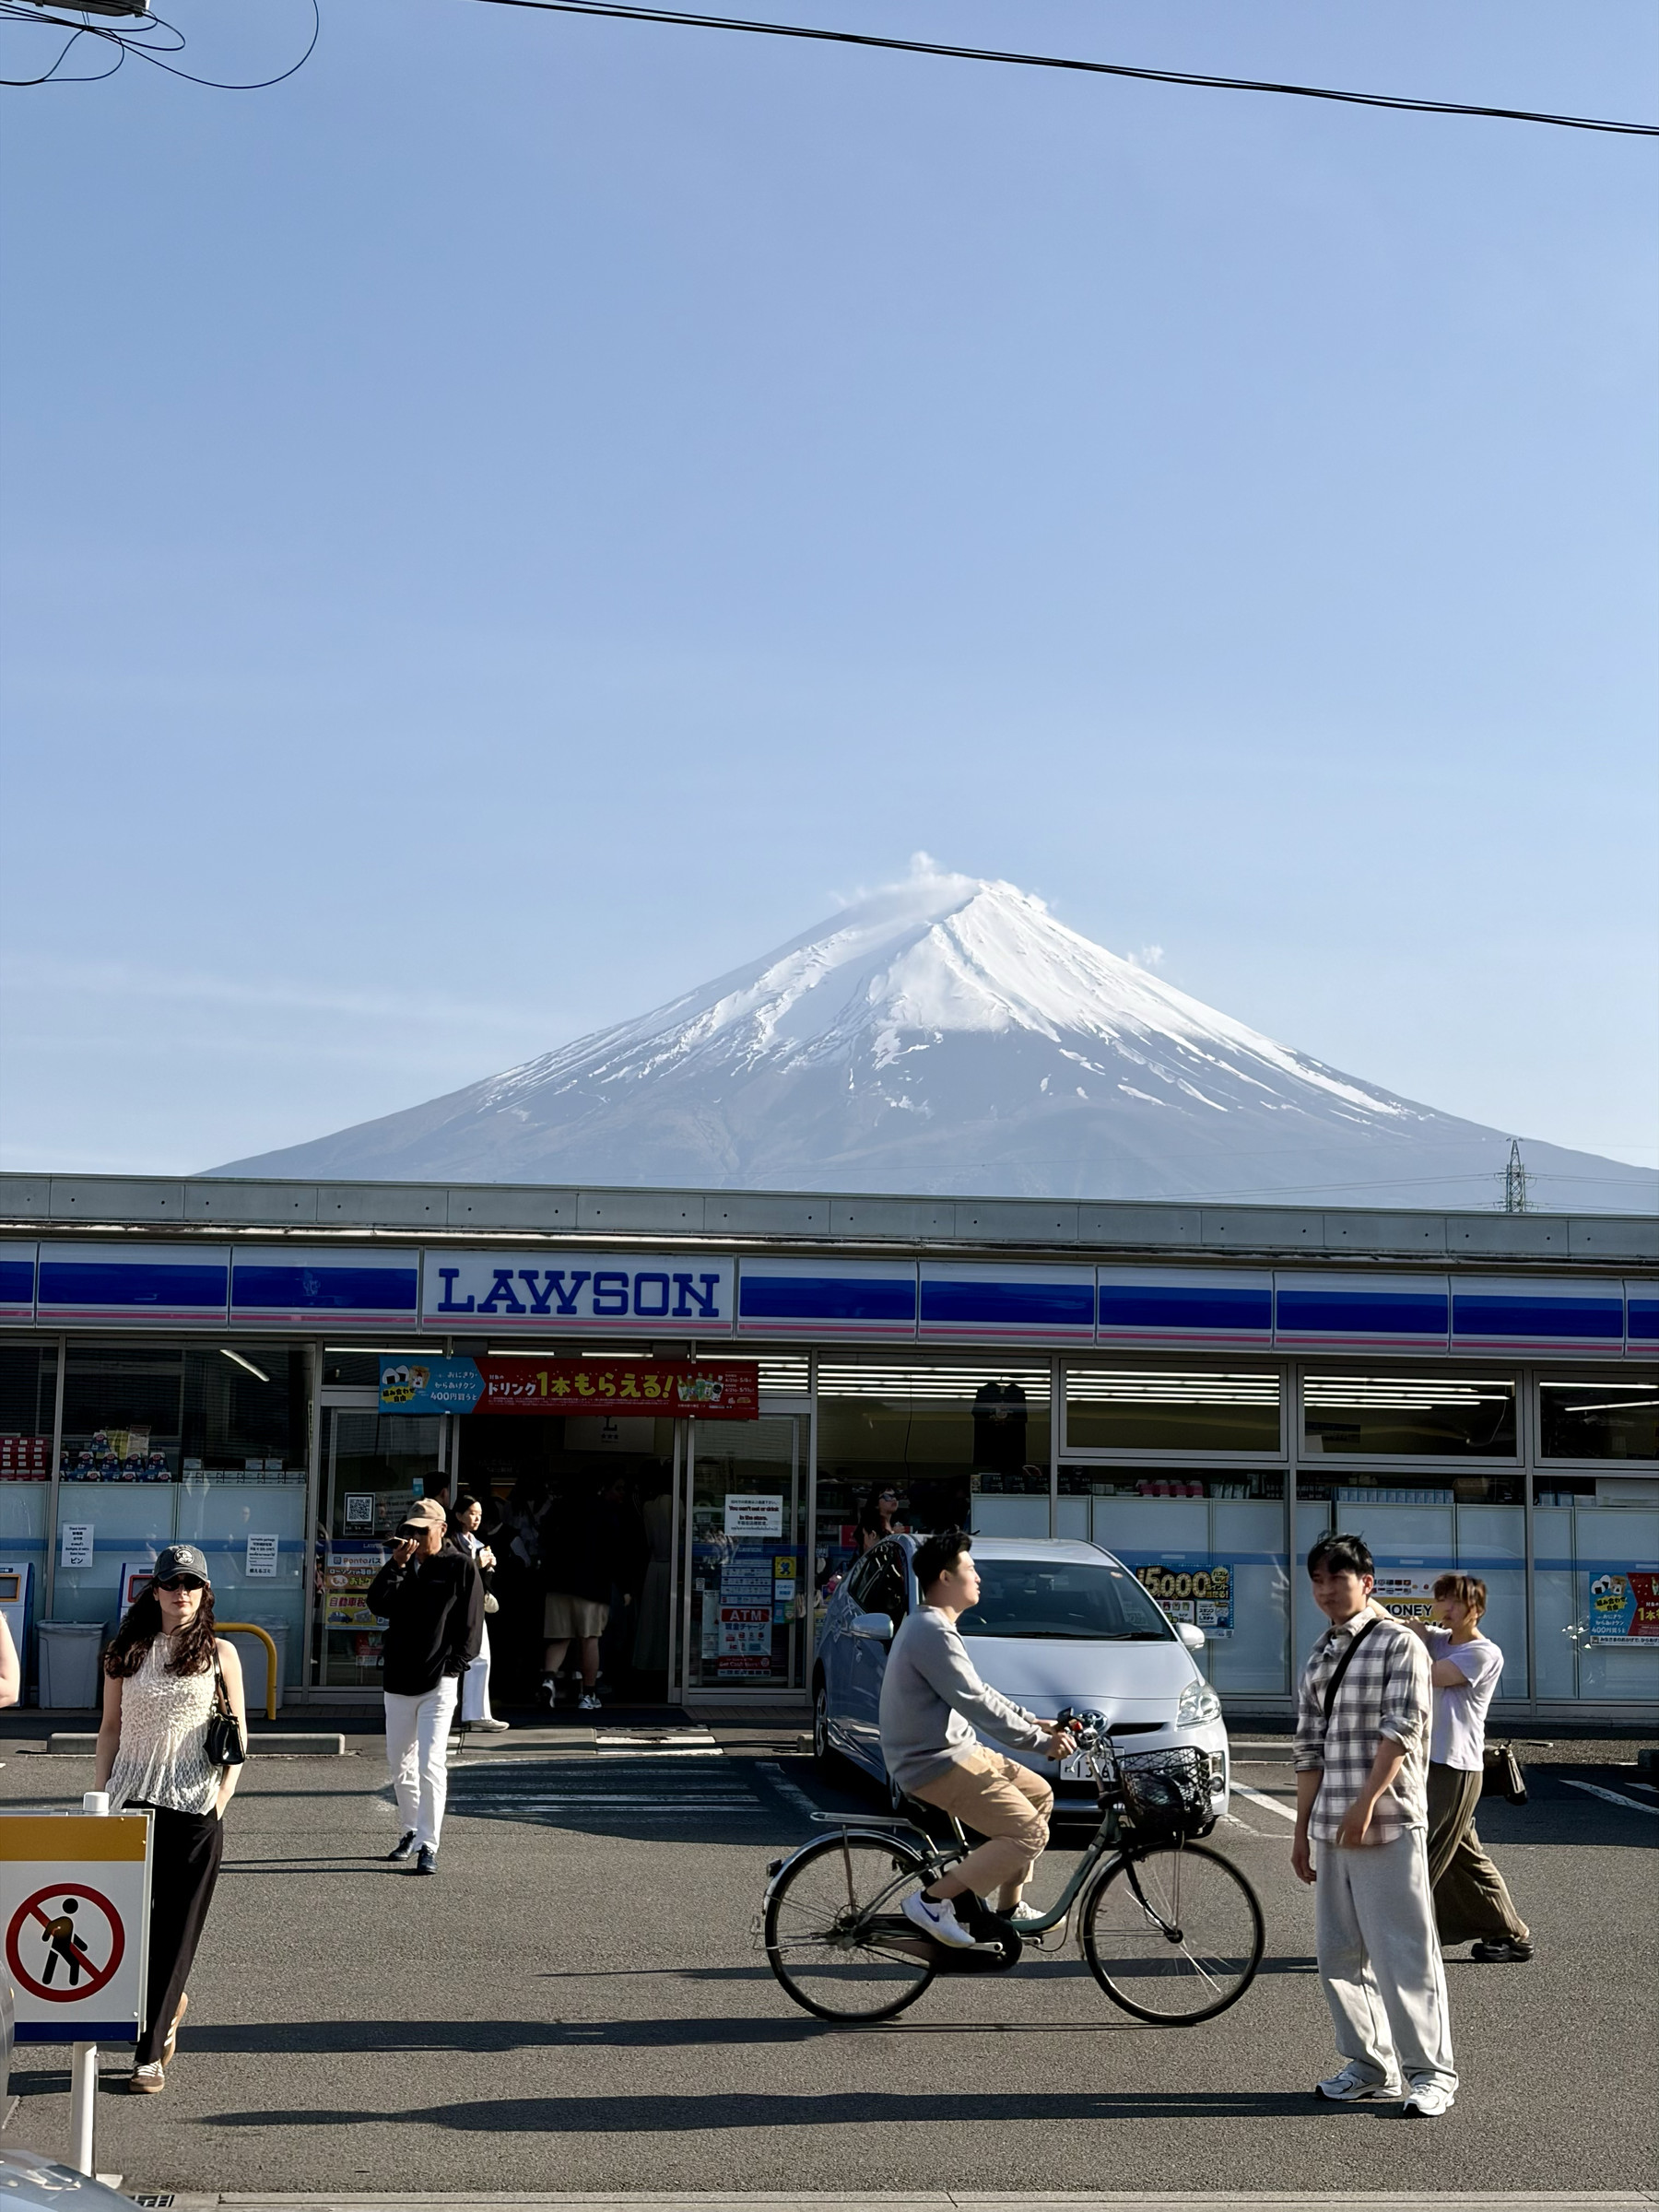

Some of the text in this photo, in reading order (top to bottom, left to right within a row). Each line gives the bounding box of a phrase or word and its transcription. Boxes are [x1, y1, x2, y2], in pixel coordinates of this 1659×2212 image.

[438, 1267, 720, 1317] LAWSON
[435, 1382, 477, 1390] からあげクン
[488, 1382, 536, 1396] ドリンク
[394, 1394, 406, 1403] 自由
[430, 1392, 478, 1401] 400円買うと
[729, 1609, 762, 1621] ATM
[1638, 1607, 1659, 1621] 1本
